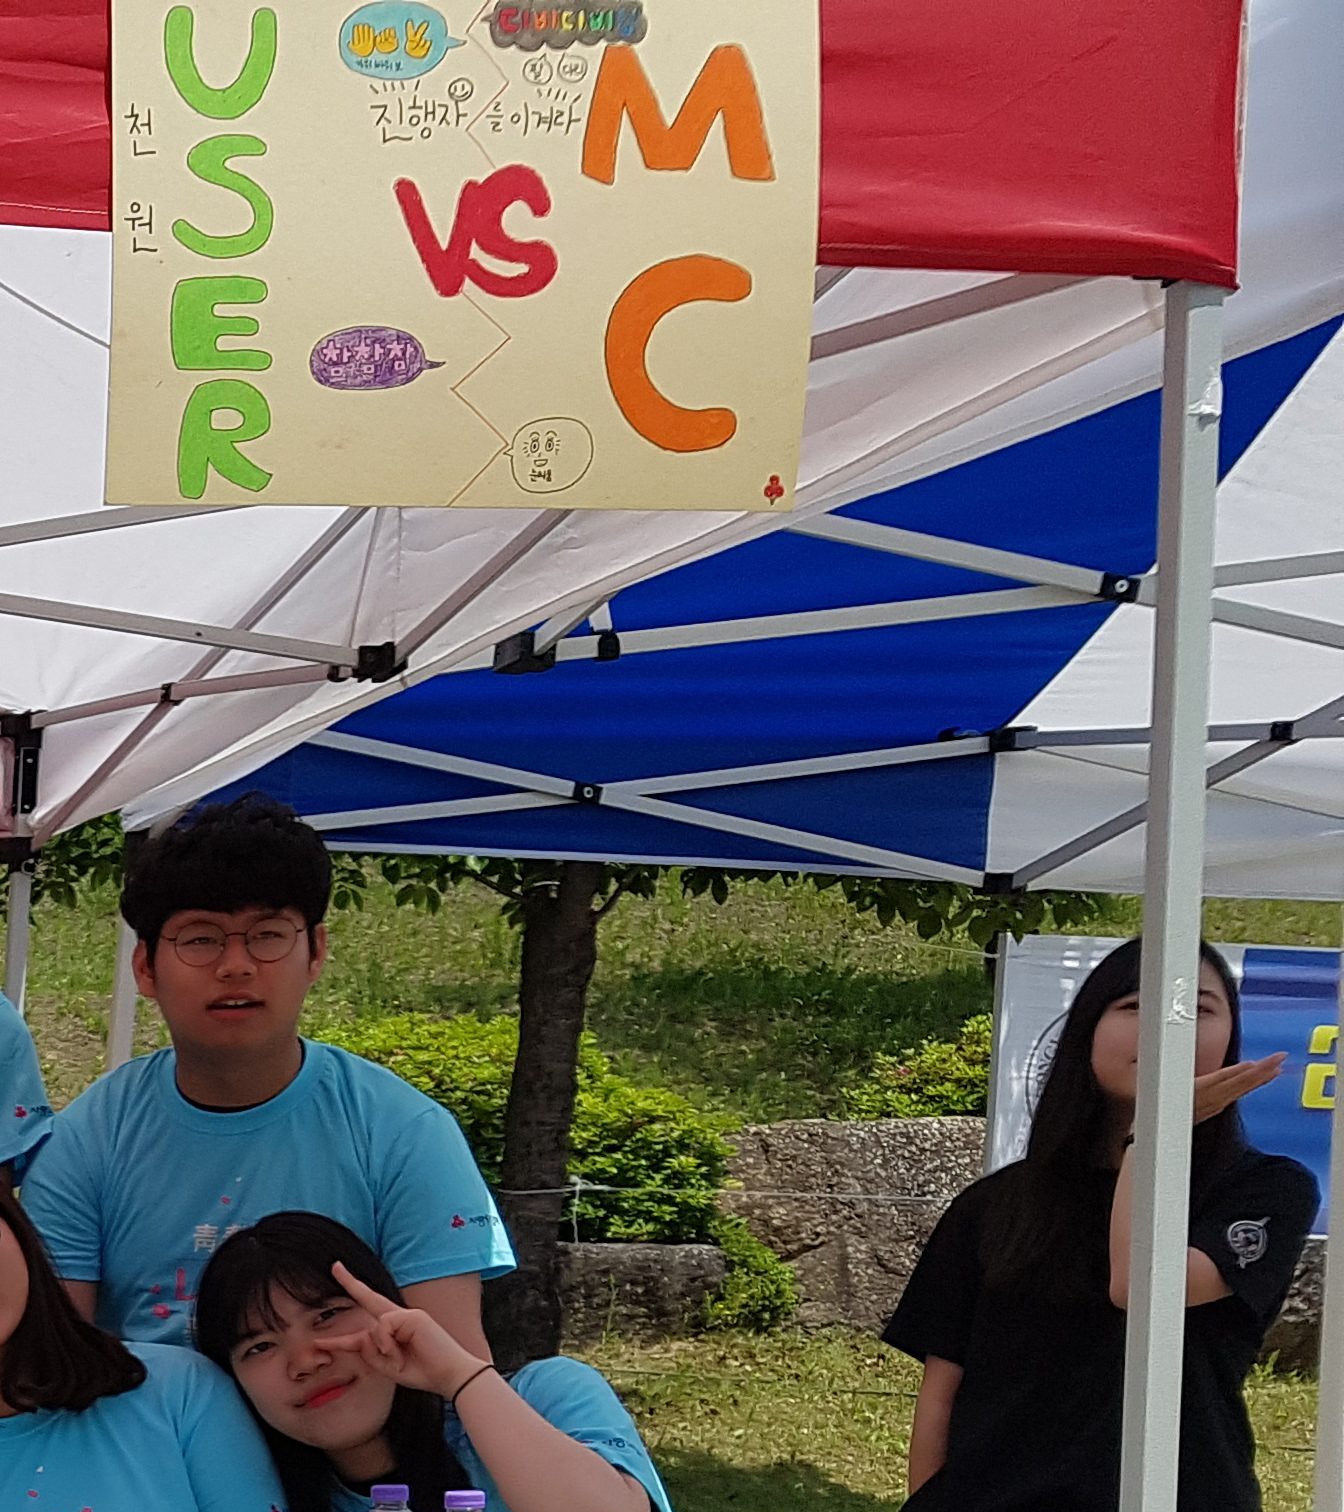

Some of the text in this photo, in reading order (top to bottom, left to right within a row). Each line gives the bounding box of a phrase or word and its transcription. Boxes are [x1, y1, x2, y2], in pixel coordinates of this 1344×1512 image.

[510, 99, 582, 137] 이겨라
[164, 5, 277, 499] USER
[393, 164, 559, 298] VS
